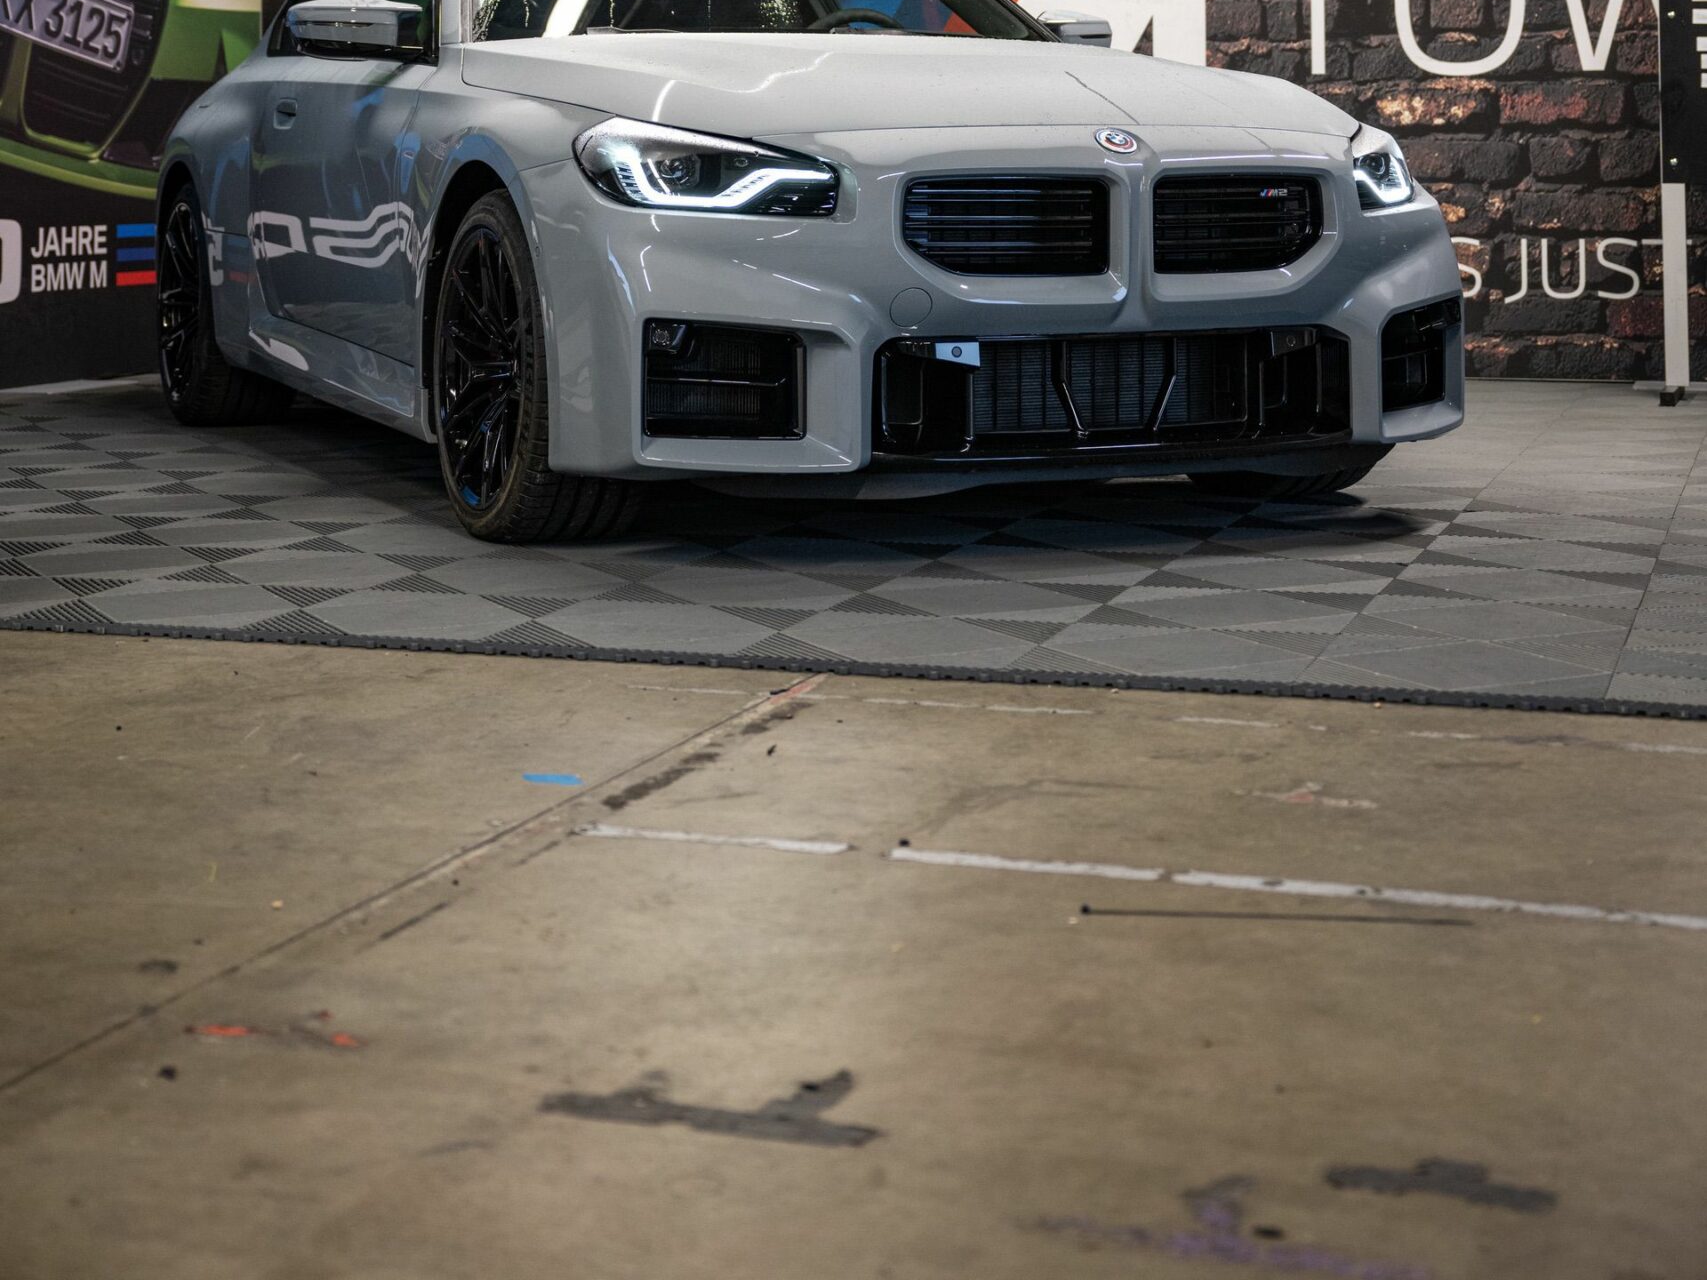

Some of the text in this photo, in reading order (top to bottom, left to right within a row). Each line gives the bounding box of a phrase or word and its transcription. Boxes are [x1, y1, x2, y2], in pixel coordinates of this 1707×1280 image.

[30, 224, 108, 259] JAHRE
[30, 260, 108, 294] BMW M
[1503, 236, 1693, 305] JUS
